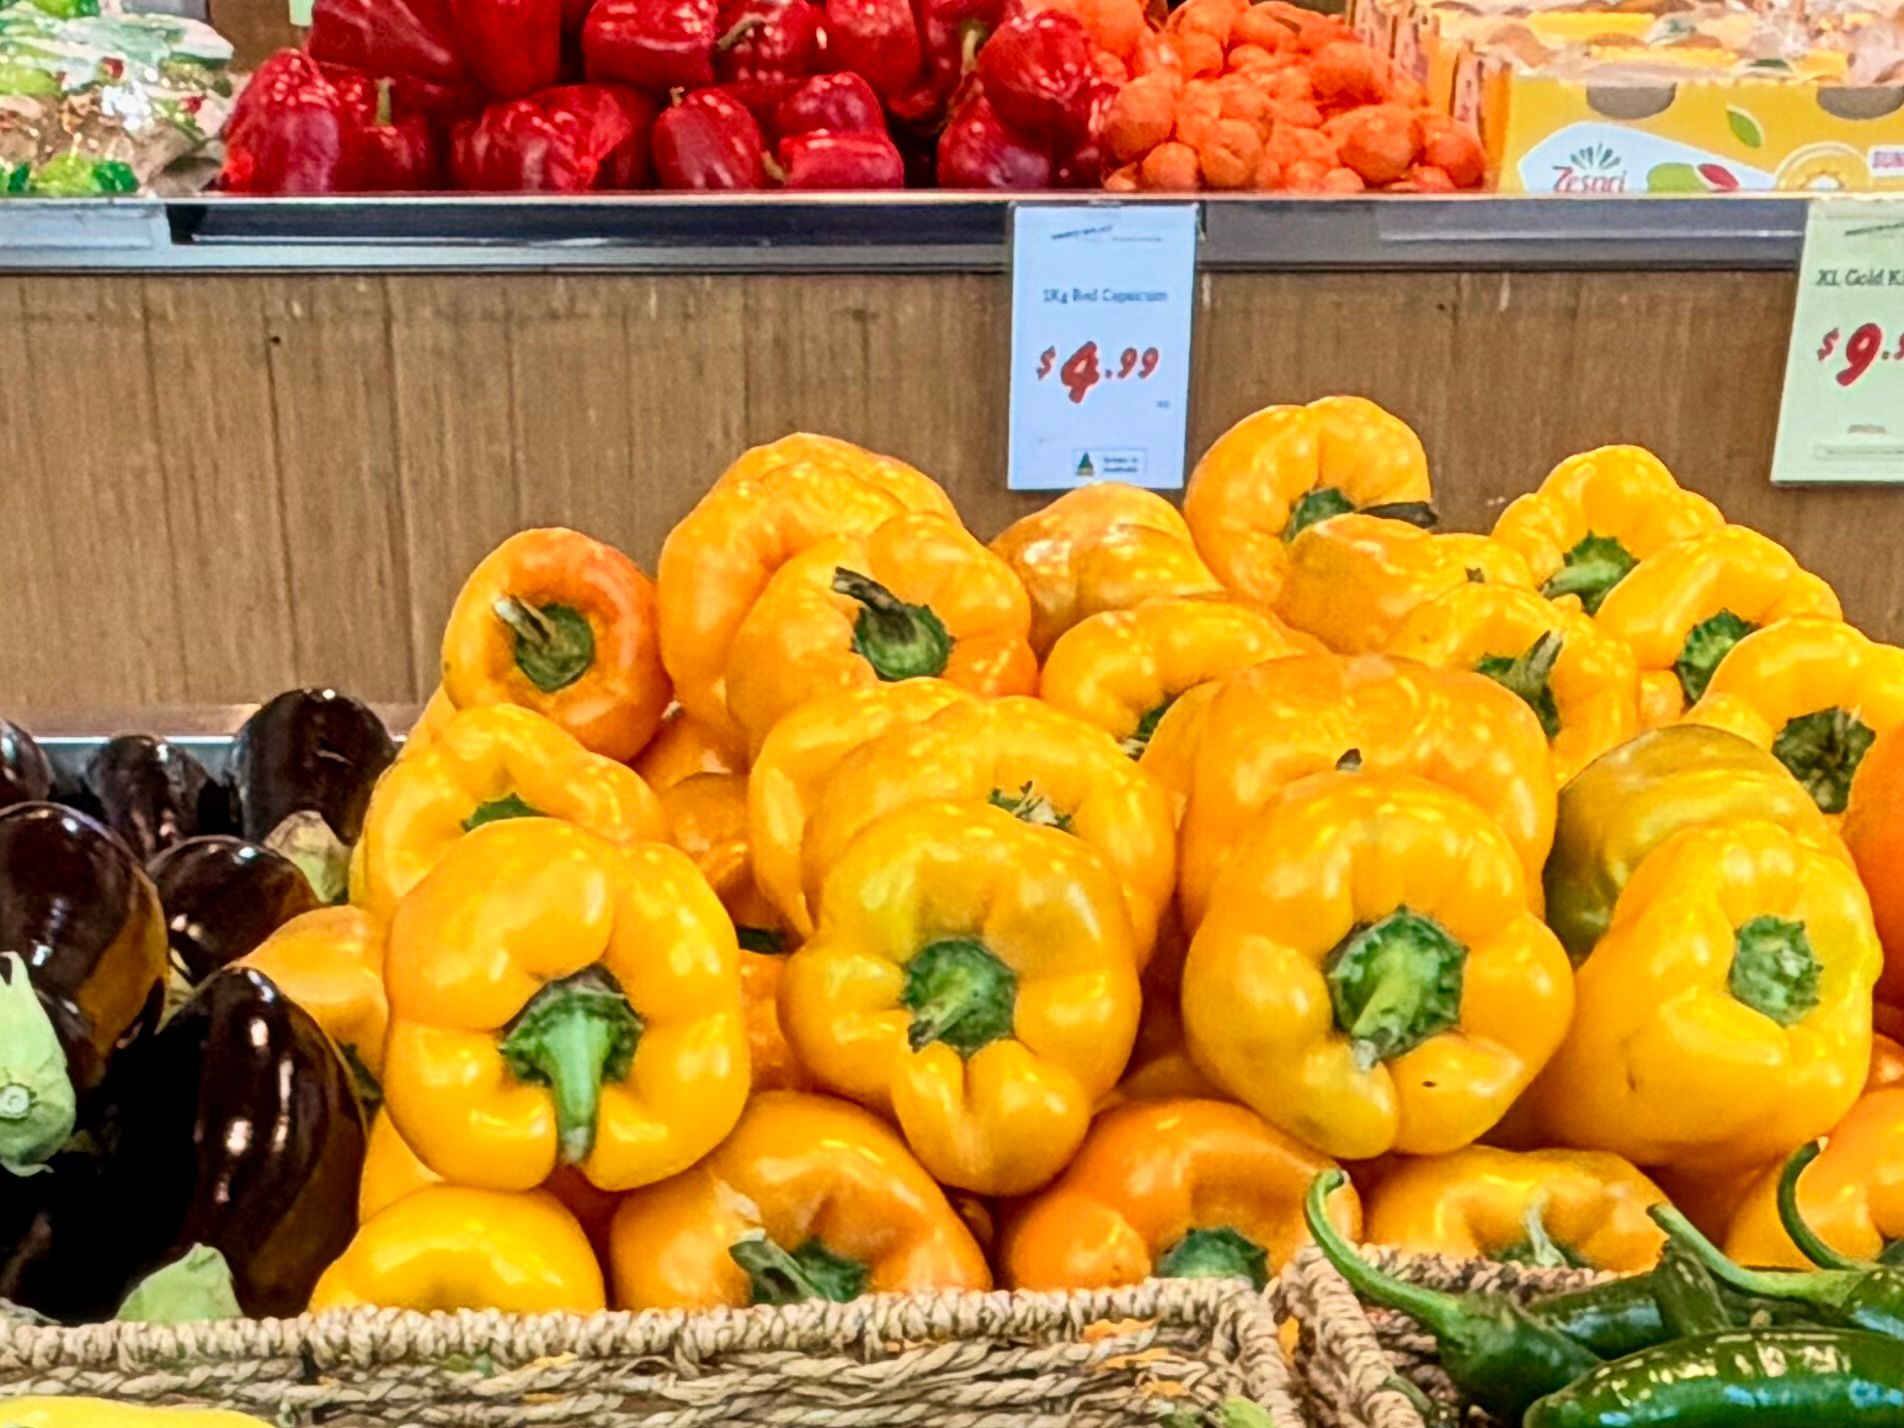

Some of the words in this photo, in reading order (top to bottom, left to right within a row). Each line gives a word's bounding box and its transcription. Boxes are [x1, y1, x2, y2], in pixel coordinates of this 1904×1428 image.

[1815, 268, 1840, 287] XL
[1844, 268, 1885, 287] Gold
[1072, 288, 1098, 302] Red
[1036, 340, 1160, 405] $4.99
